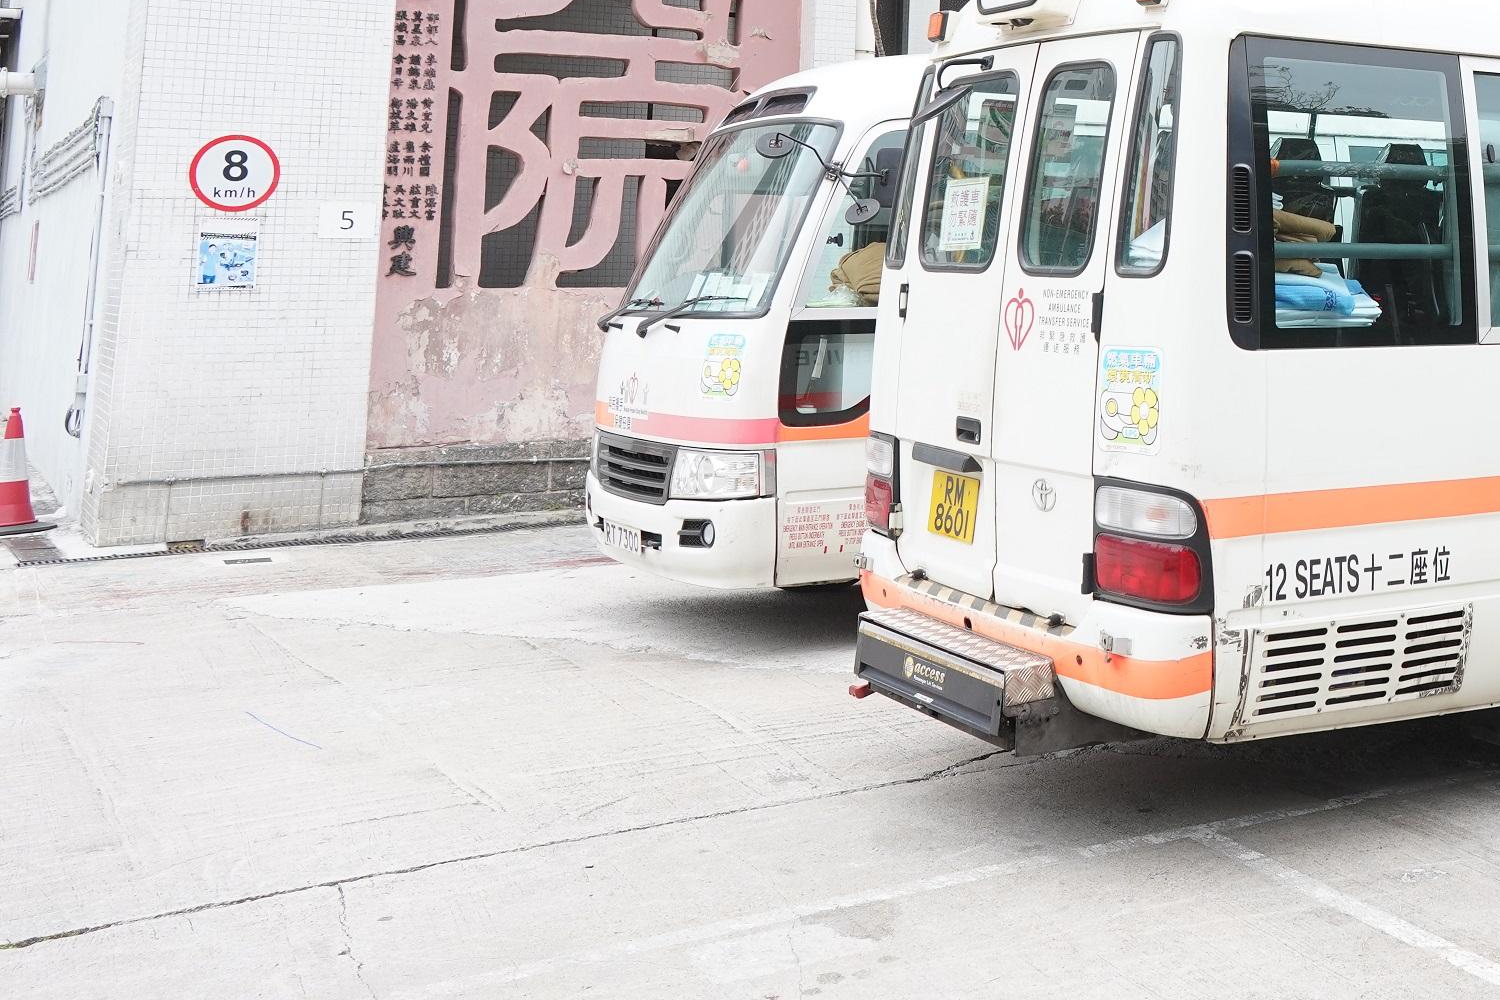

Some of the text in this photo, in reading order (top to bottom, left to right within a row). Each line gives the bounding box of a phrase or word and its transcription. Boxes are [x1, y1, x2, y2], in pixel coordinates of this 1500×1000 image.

[223, 150, 249, 182] 8
[213, 187, 256, 199] km/h
[339, 210, 355, 230] 5
[1042, 289, 1090, 300] NON-EMERGENCY
[1048, 303, 1081, 314] AMBULANCE
[1039, 315, 1090, 329] TRANSFER SERVICE
[944, 475, 966, 507] RM
[934, 503, 970, 539] 8601
[606, 522, 638, 552] RT 7300
[1265, 546, 1451, 602] 12 SEATS 十二座位
[914, 663, 946, 684] access
